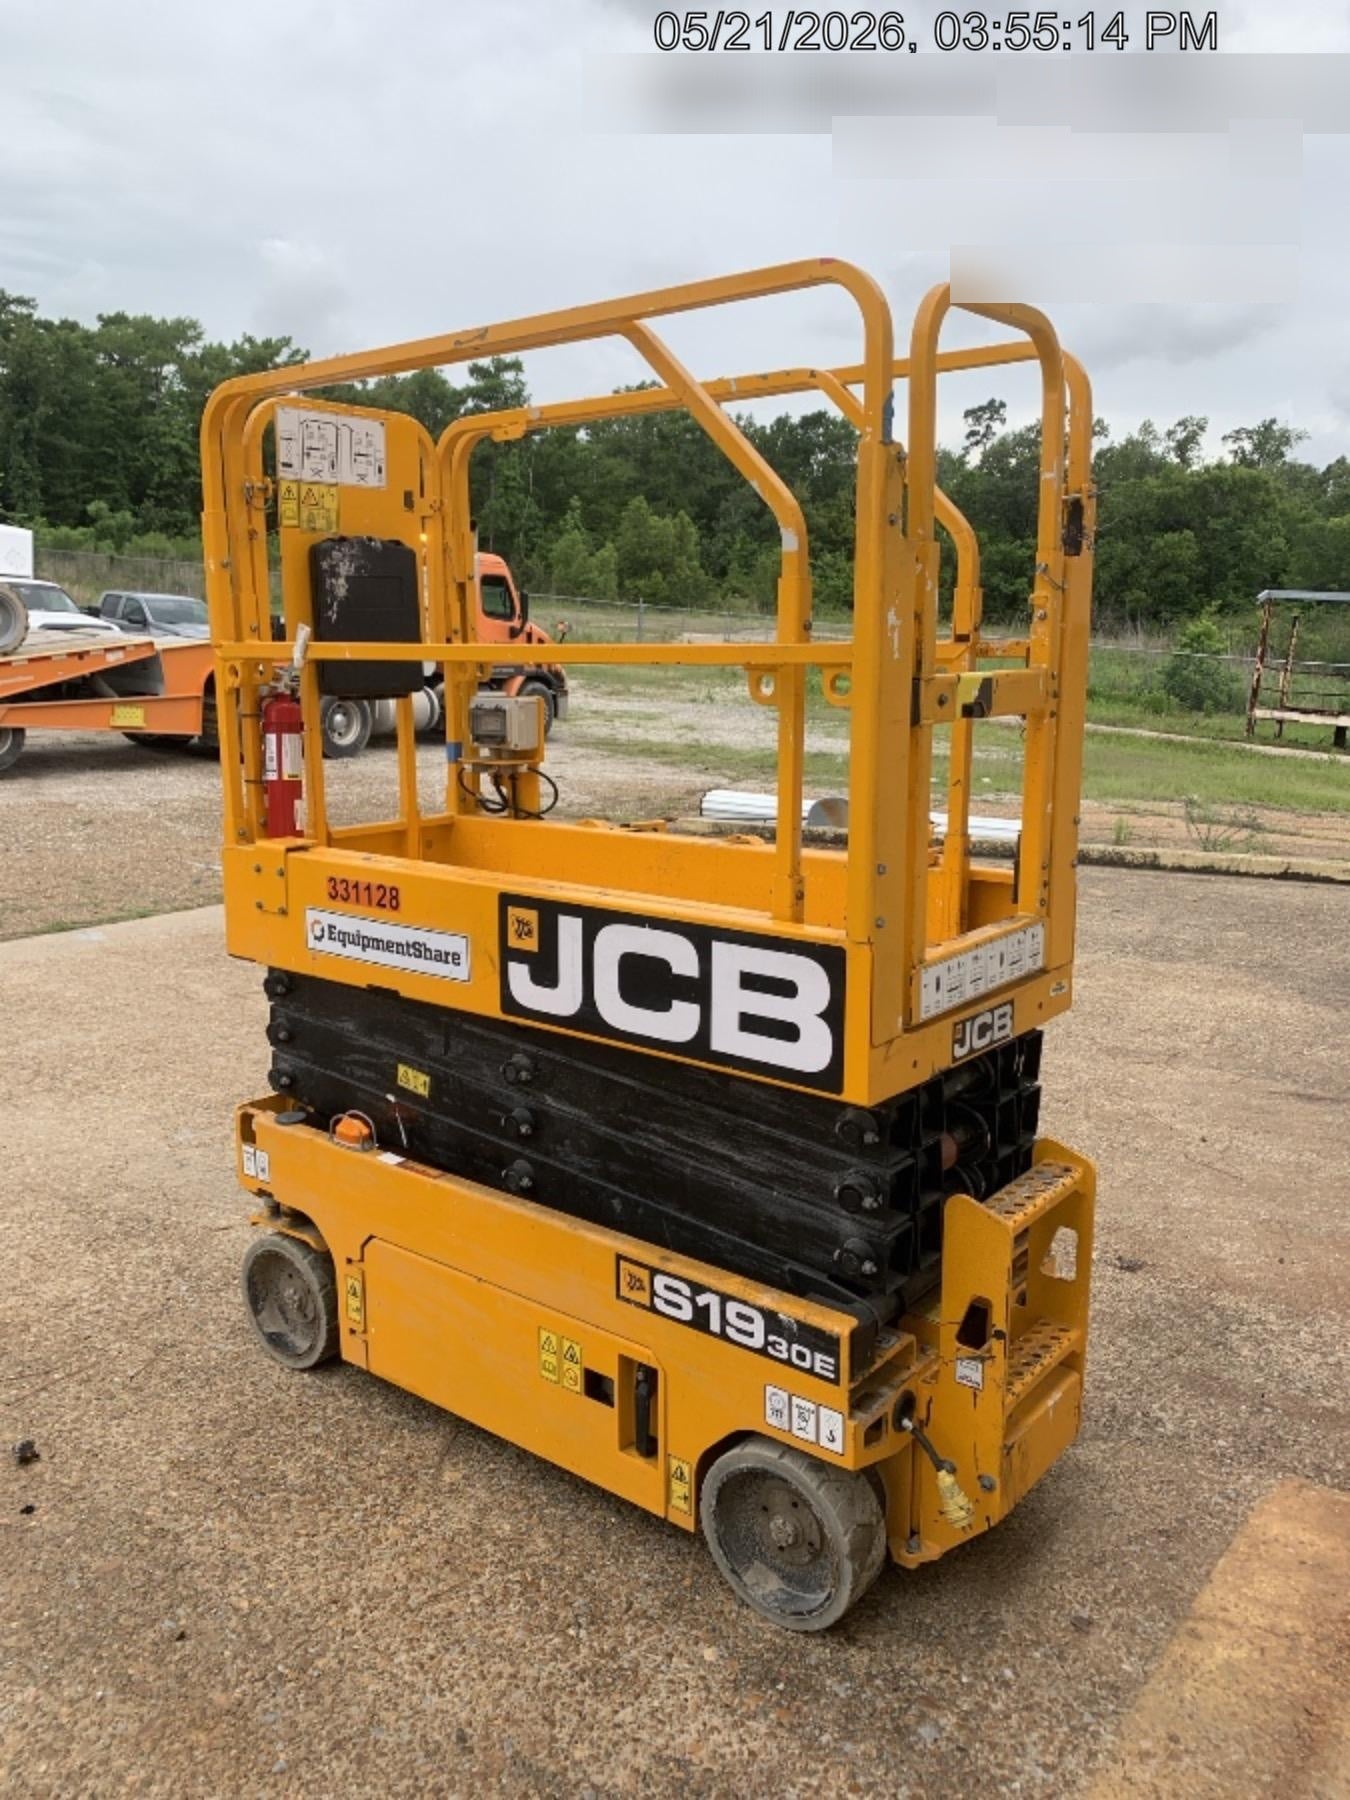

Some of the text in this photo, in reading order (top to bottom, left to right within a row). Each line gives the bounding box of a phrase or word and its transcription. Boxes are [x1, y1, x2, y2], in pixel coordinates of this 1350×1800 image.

[327, 876, 401, 911] 331128
[327, 923, 462, 967] EquipmentShare
[507, 914, 833, 1073] JCB
[953, 1003, 1013, 1059] JCB
